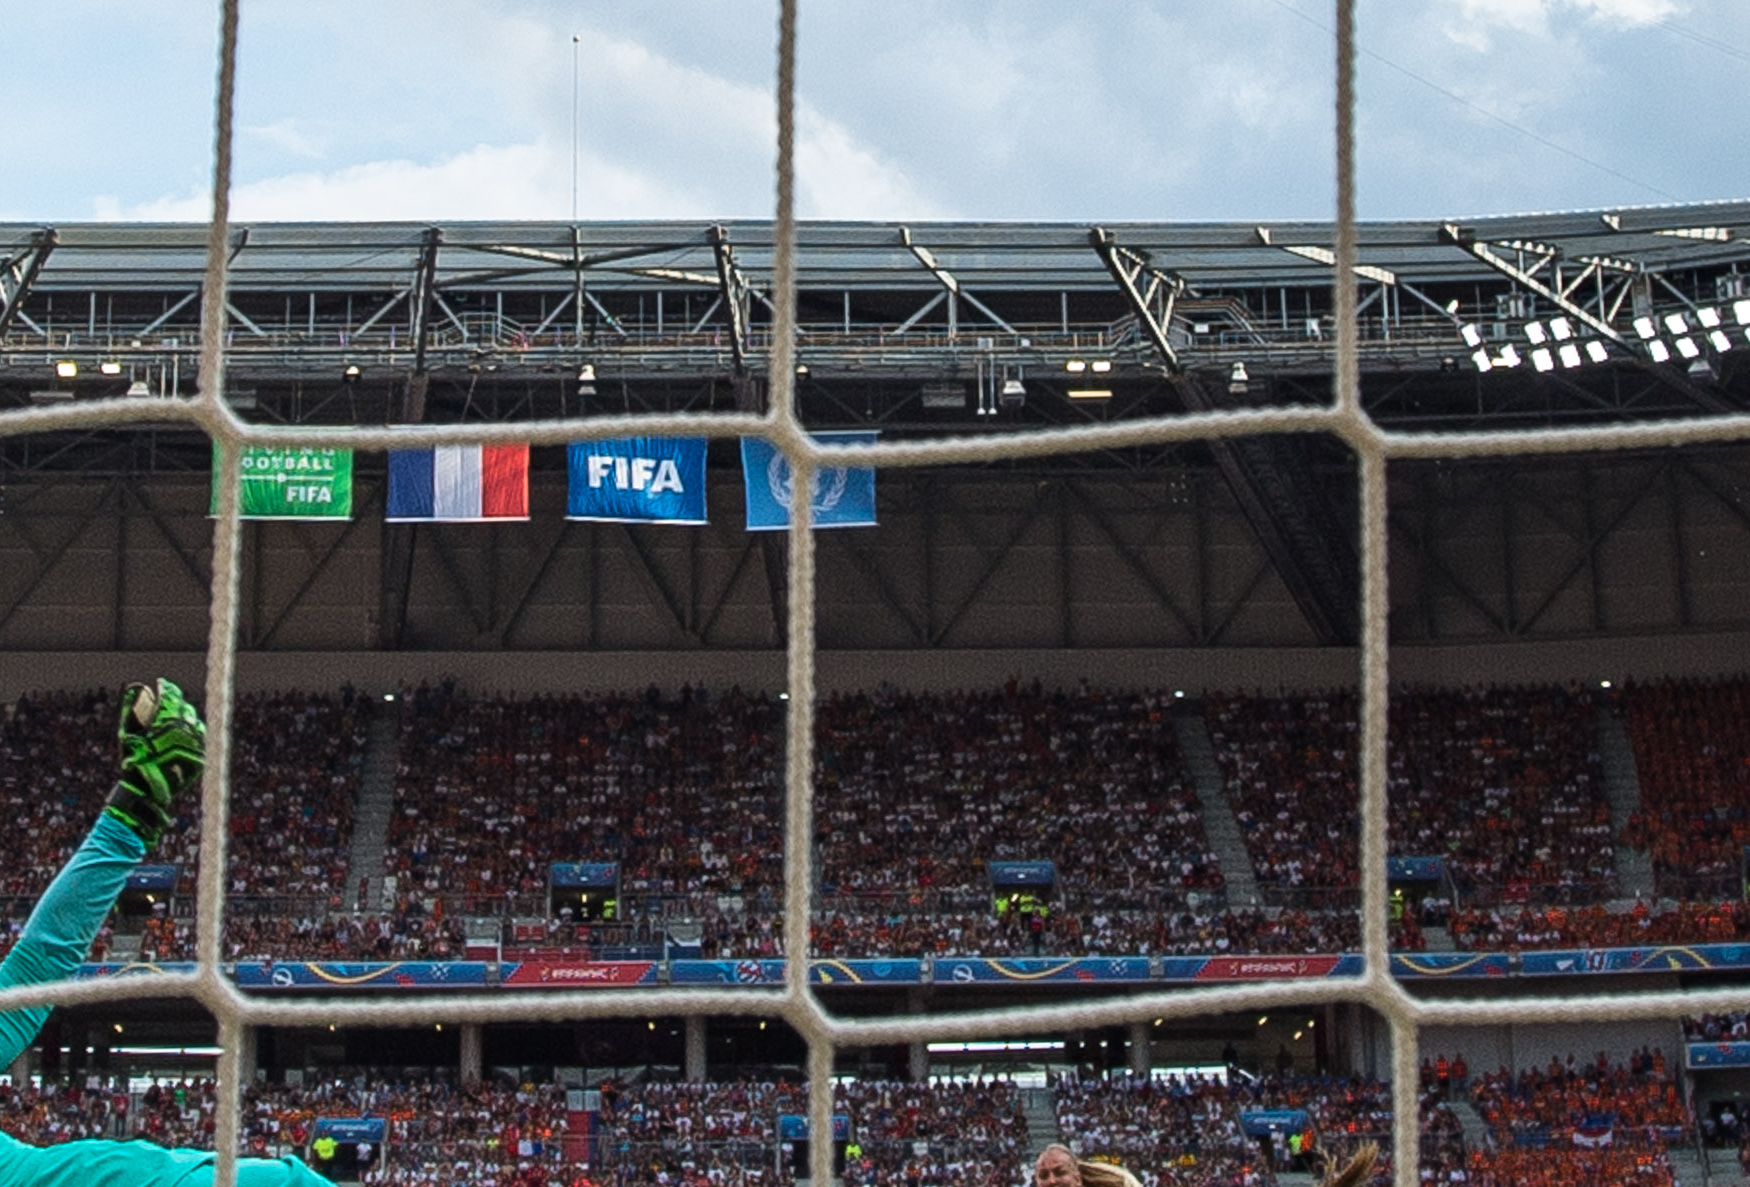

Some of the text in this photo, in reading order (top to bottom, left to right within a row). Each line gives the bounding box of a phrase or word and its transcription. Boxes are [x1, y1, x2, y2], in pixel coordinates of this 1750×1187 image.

[241, 456, 334, 471] OOTBALL
[588, 455, 684, 493] FIFA
[286, 486, 331, 502] FIFA
